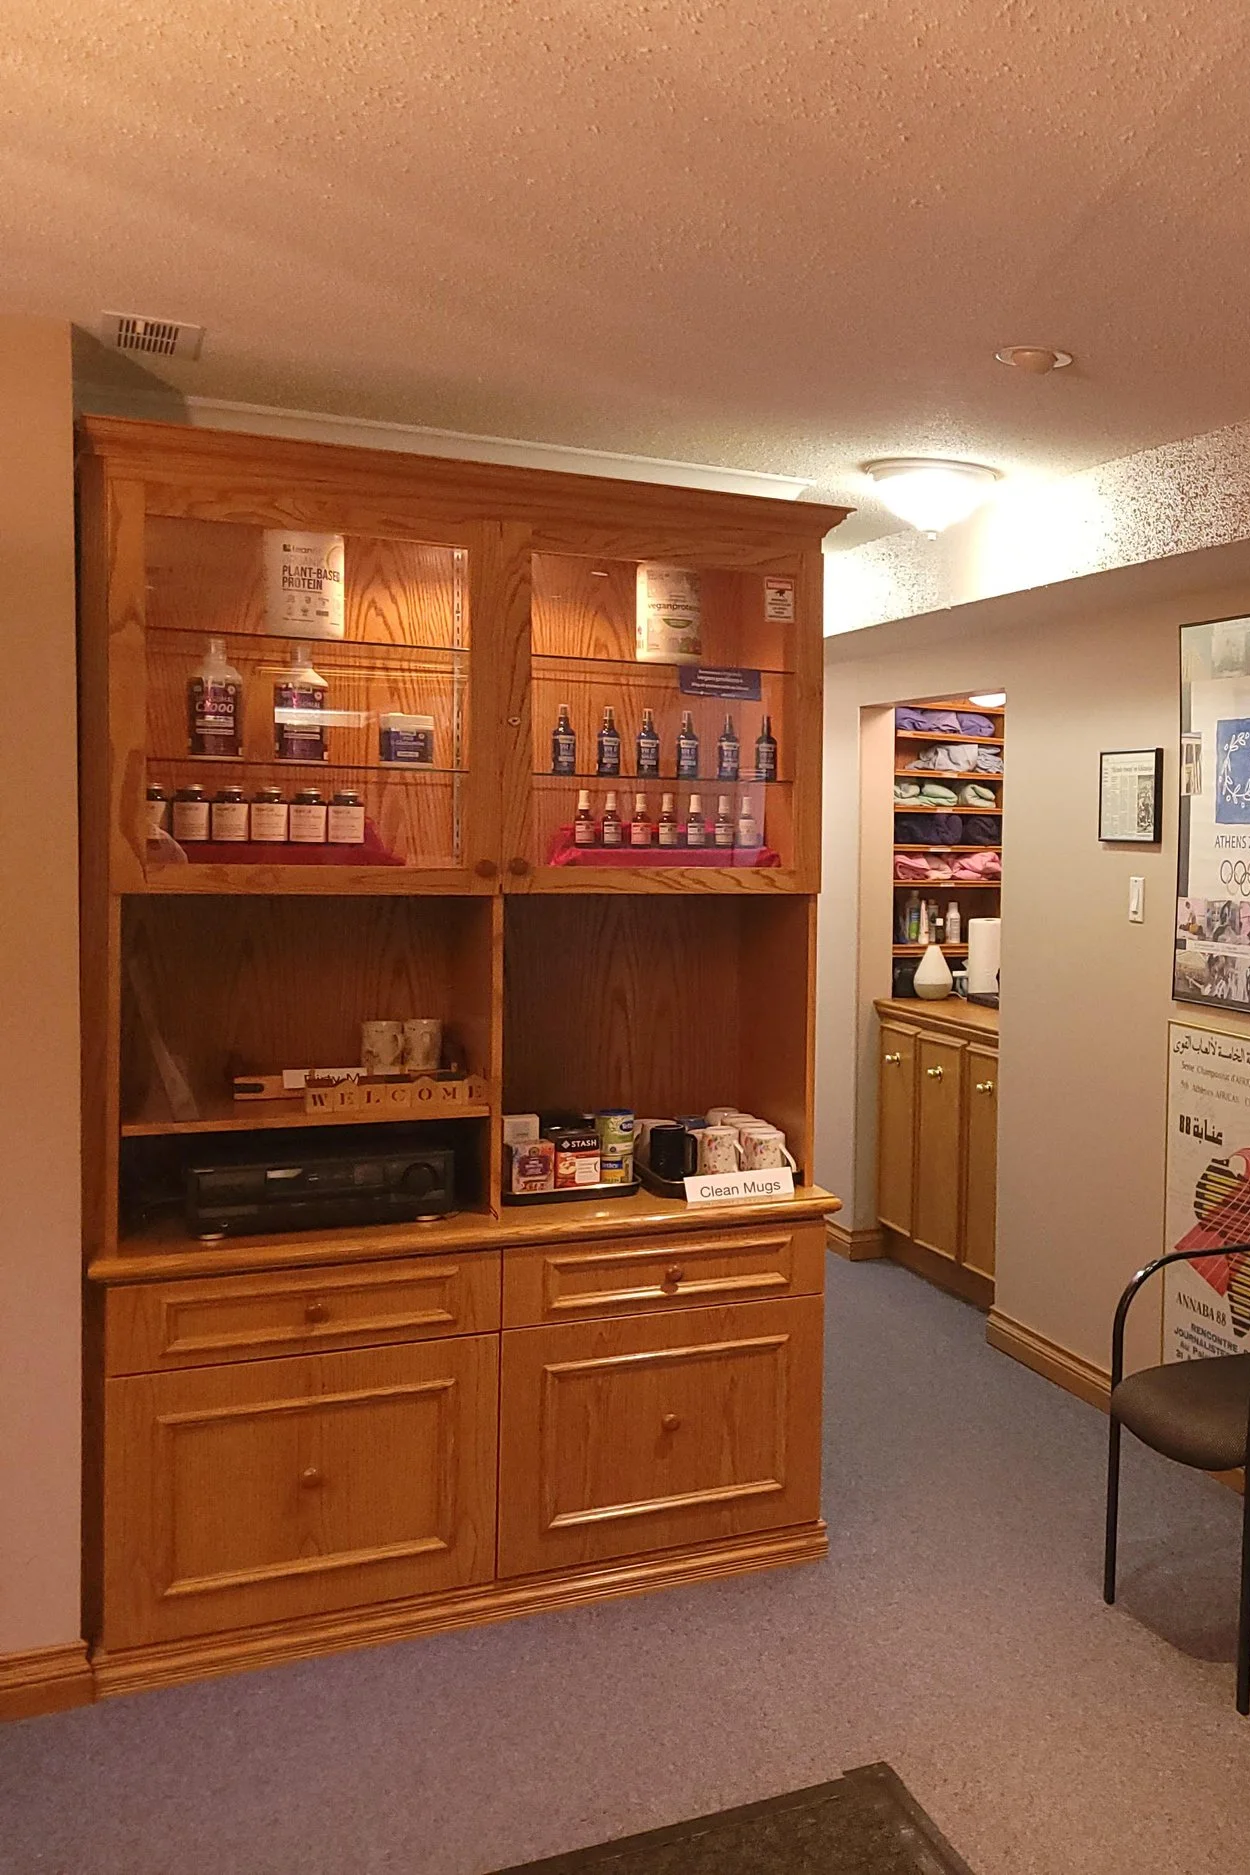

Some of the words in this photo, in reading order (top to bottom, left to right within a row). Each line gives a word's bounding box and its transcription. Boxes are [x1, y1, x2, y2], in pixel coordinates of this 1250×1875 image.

[282, 565, 341, 582] PLANT-BASED
[282, 576, 323, 590] PROTEIN
[1215, 835, 1247, 849] ATHENS
[310, 1084, 483, 1107] WELCOME
[1179, 1114, 1191, 1136] 88
[1193, 1116, 1224, 1146] عنابة
[571, 1139, 598, 1149] STASH
[699, 1182, 740, 1198] Clean
[743, 1179, 782, 1196] Mugs
[1175, 1291, 1215, 1321] ANNABA
[1216, 1310, 1227, 1327] 88
[1174, 1327, 1229, 1356] JOURNALISTE
[1191, 1322, 1239, 1353] RENCONTRE
